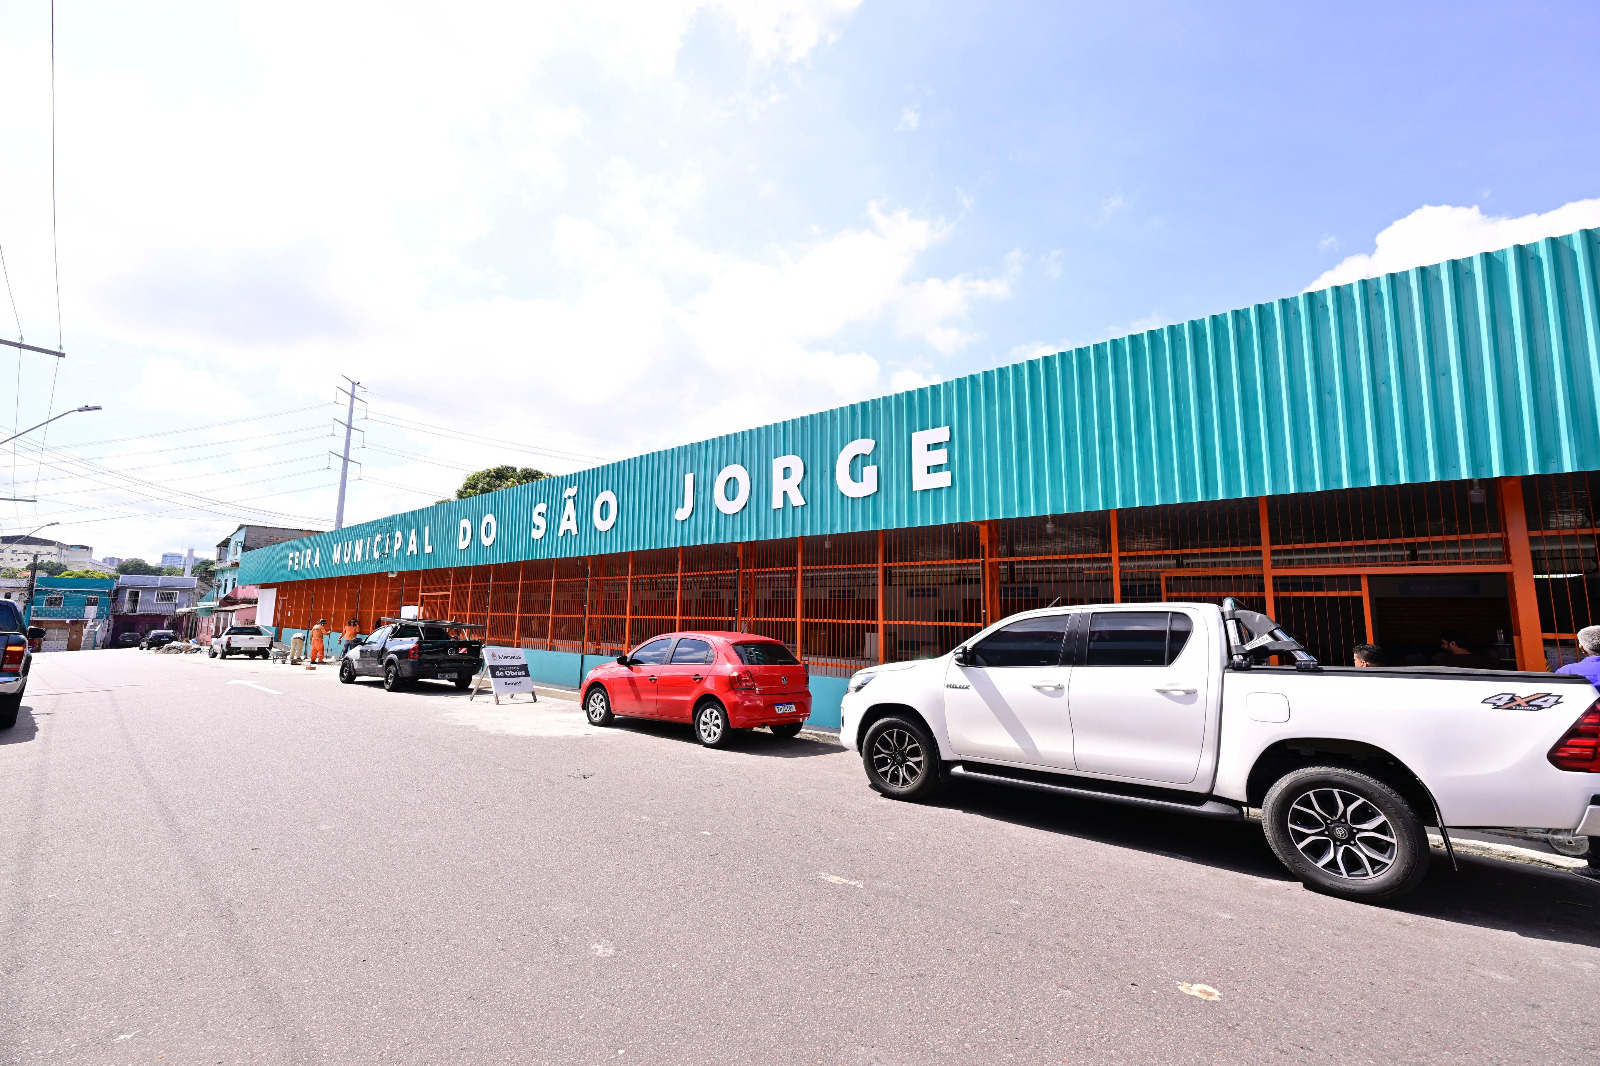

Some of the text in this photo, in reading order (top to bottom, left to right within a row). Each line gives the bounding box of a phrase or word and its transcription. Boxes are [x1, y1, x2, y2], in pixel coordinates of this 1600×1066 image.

[287, 426, 952, 572] FEIRA MUNICIPAL DO SÃO JORGE
